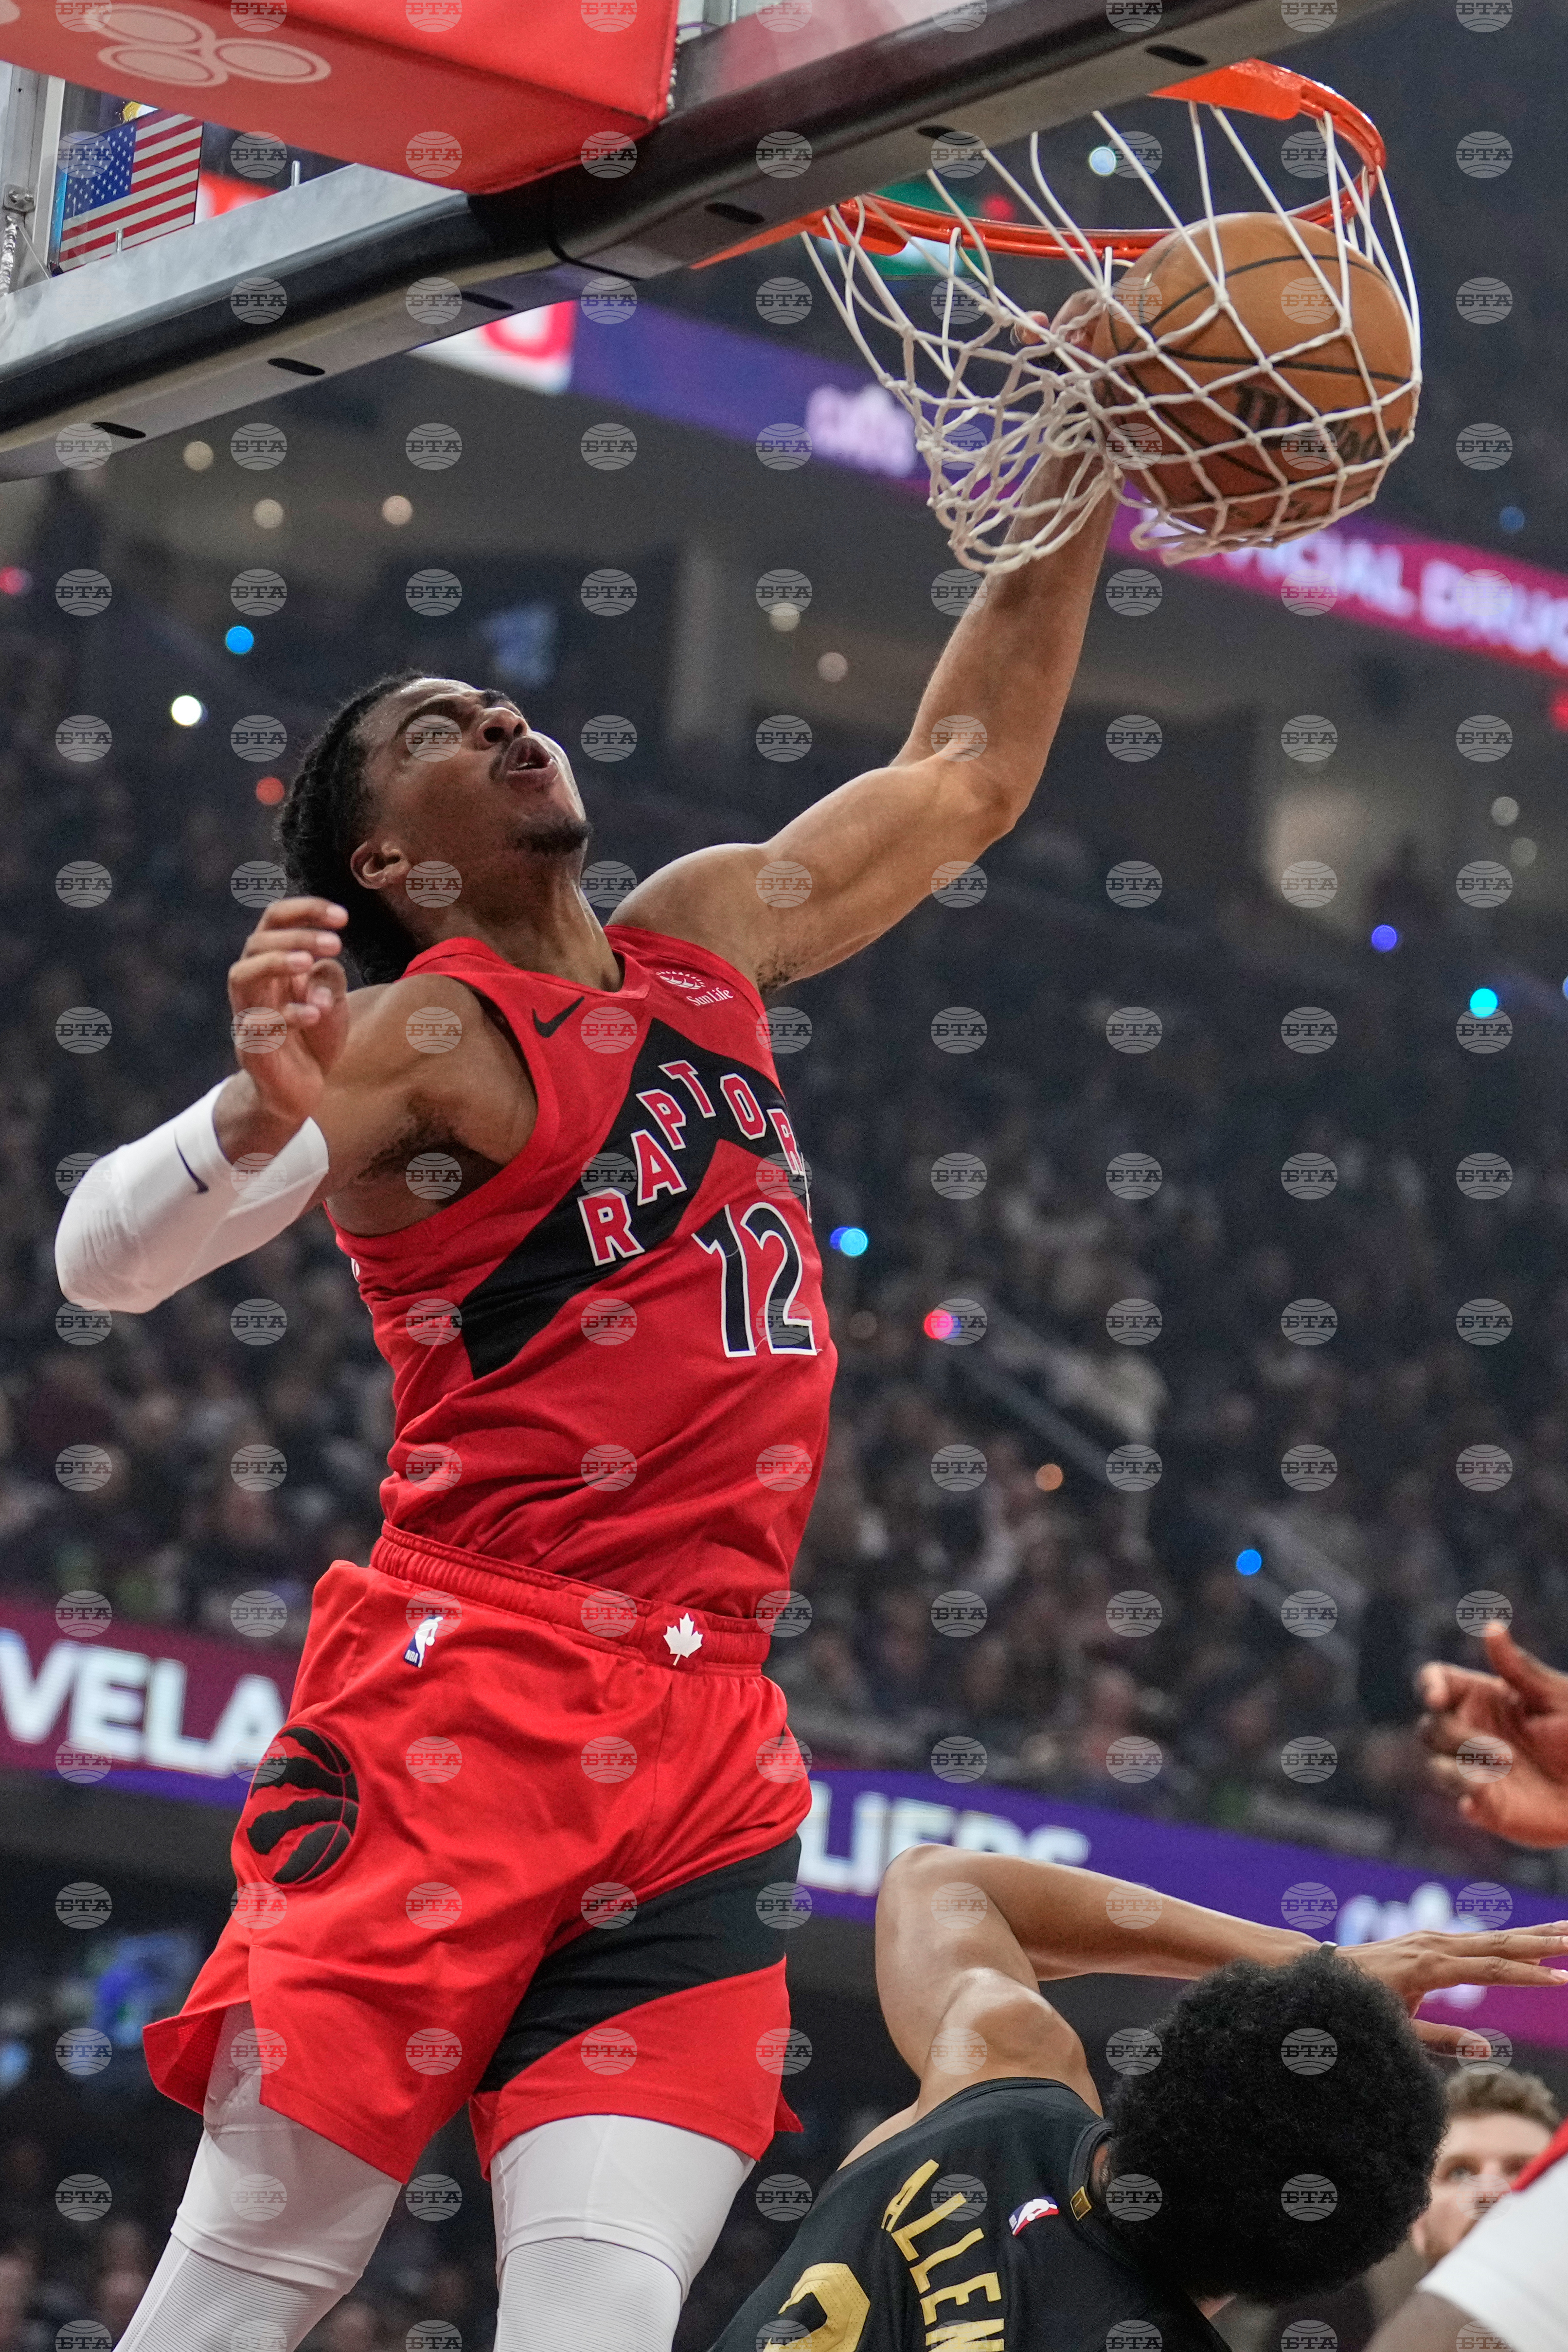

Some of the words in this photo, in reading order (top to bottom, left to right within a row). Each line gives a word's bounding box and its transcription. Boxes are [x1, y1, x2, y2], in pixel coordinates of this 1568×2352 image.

[686, 995, 715, 1006] Sun
[705, 987, 734, 1001] Life
[577, 1059, 813, 1266] RAPTOR
[691, 1201, 818, 1358] 12
[404, 1649, 419, 1663] NBA
[881, 2158, 1005, 2352] ALLEN
